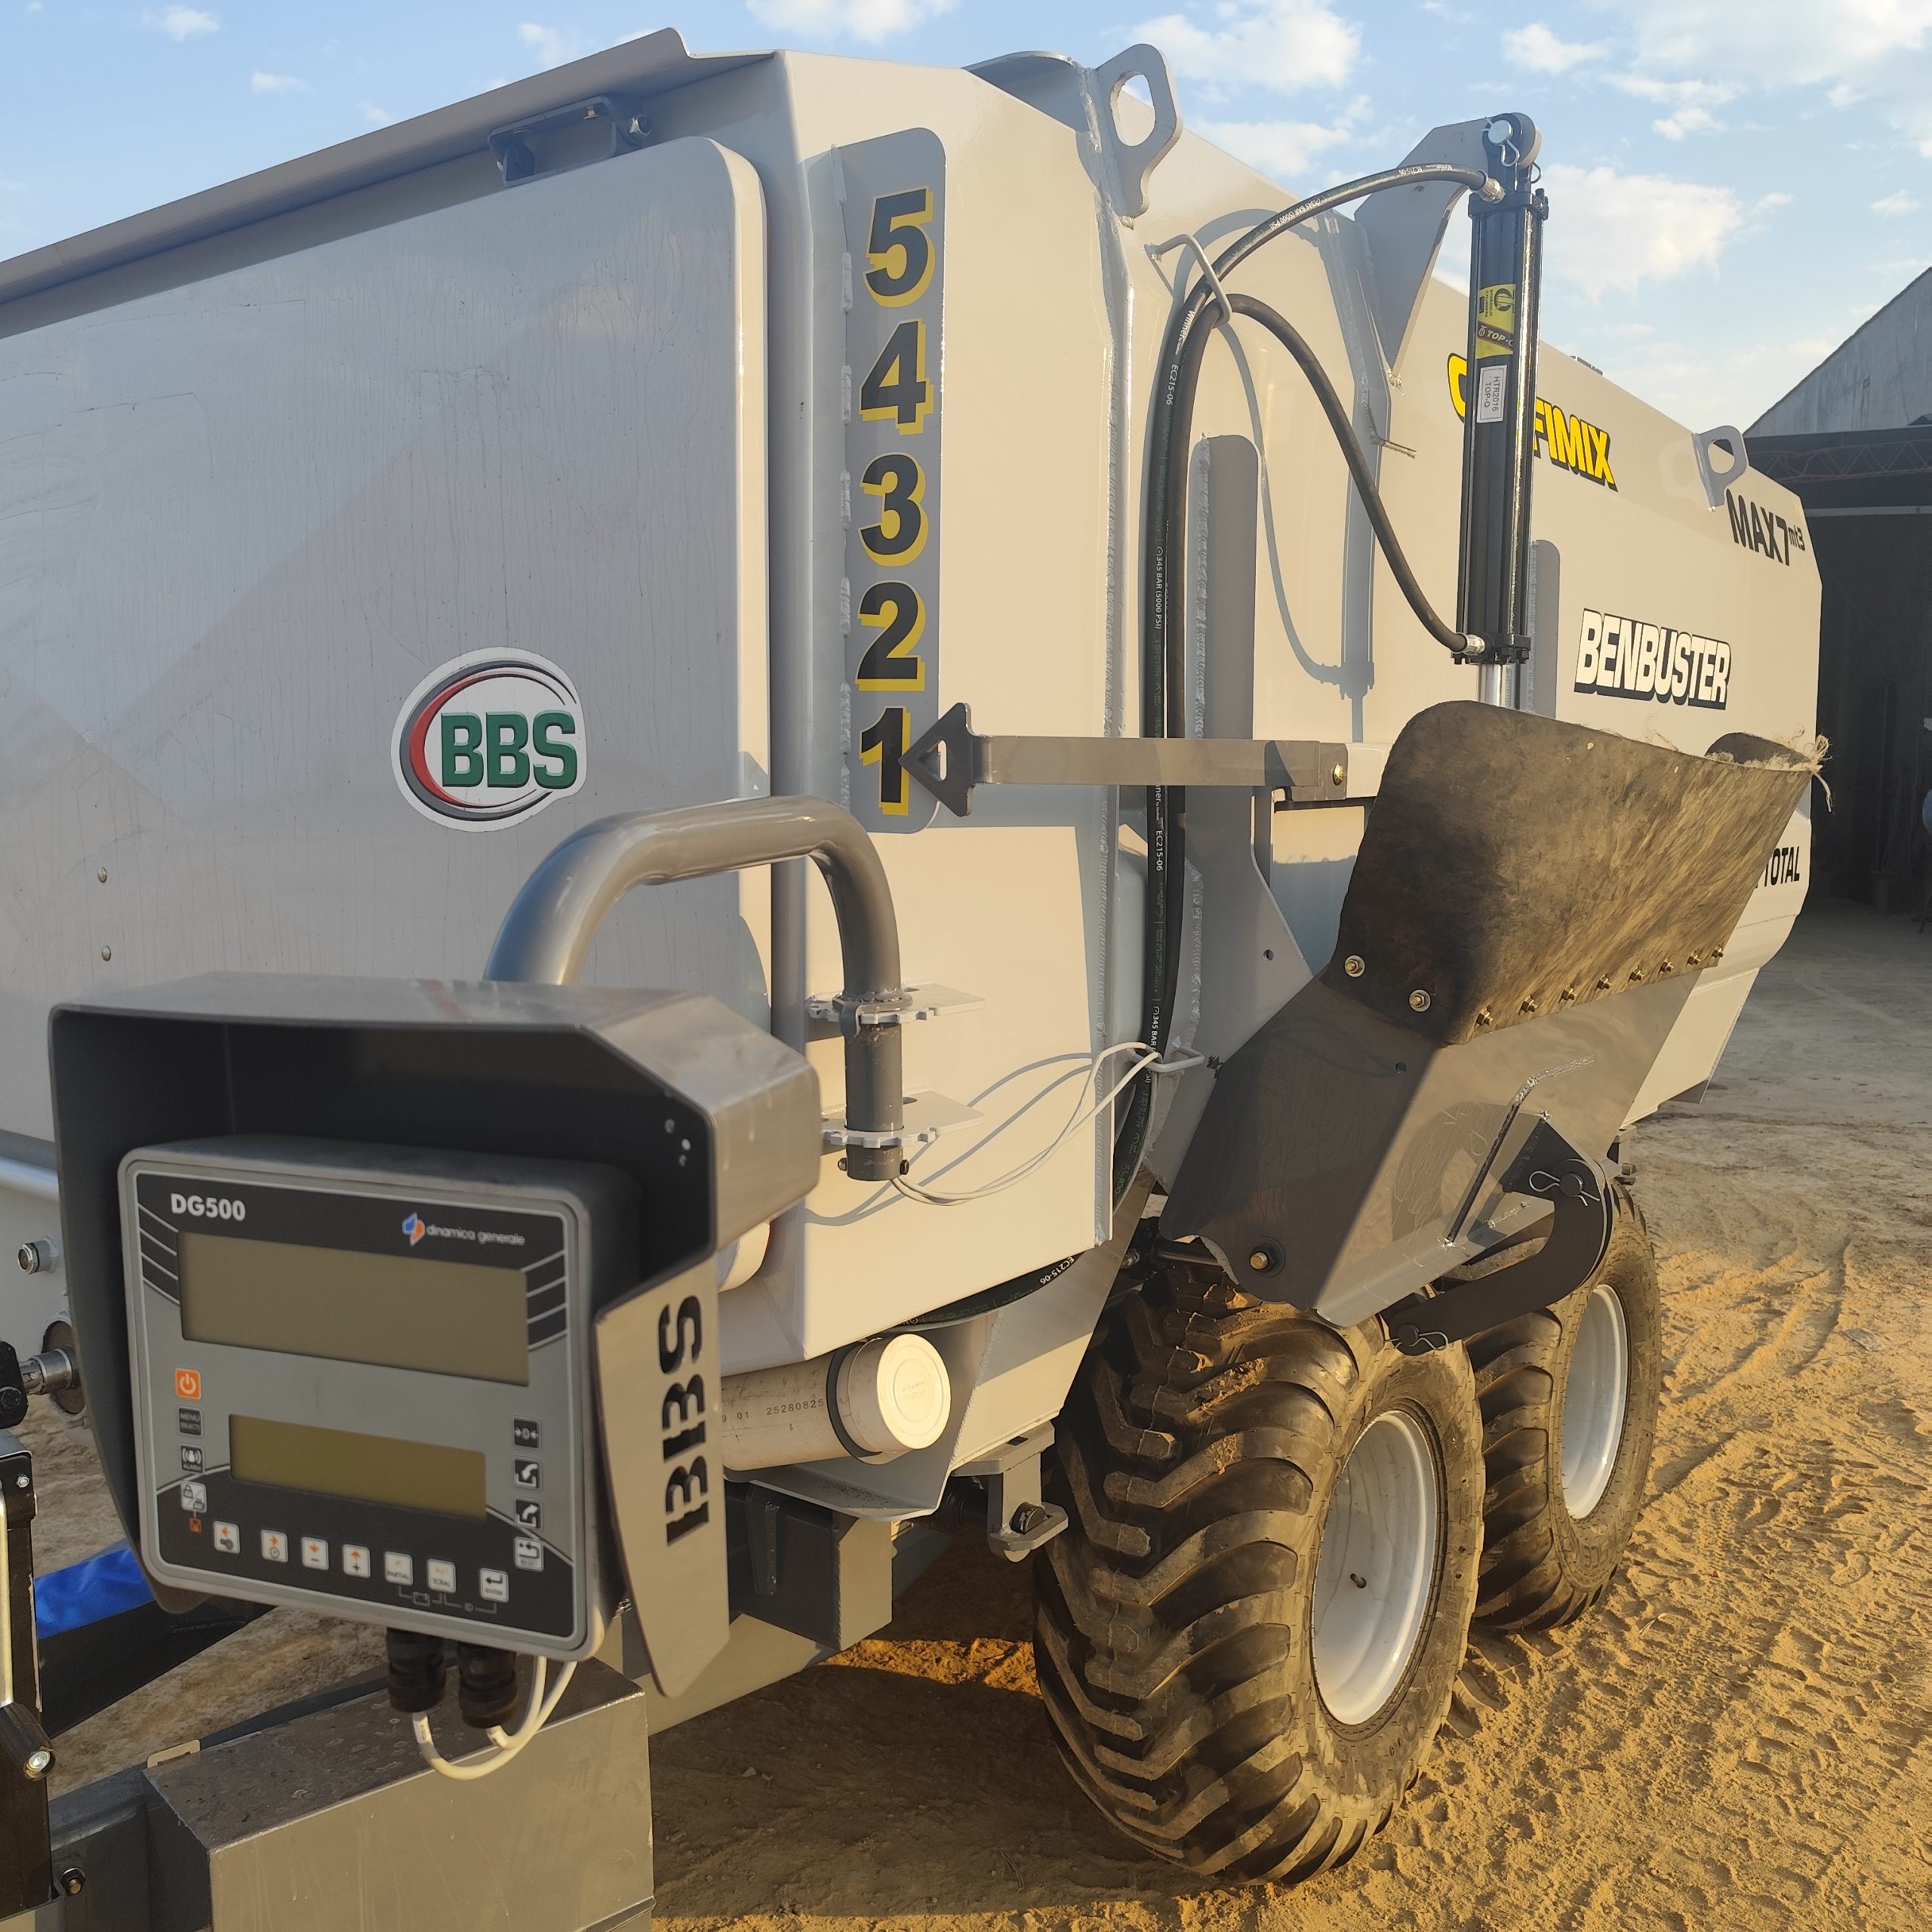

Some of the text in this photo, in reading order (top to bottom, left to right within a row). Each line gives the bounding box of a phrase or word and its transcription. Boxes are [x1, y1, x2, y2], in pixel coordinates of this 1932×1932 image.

[1294, 206, 1306, 216] BAR
[863, 186, 936, 308] 5
[1180, 310, 1196, 340] Winner
[859, 318, 934, 435] 4
[1166, 364, 1179, 405] EC215-06
[1492, 376, 1500, 412] HTR2016
[857, 452, 929, 566] 3
[855, 580, 926, 692] 2
[1154, 614, 1162, 629] PSI)
[1574, 608, 1732, 711] BENBUSTER
[441, 709, 578, 789] BBS
[859, 706, 912, 817] 1
[1155, 830, 1164, 872] EC215-06
[171, 1193, 246, 1221] DG500
[426, 1224, 526, 1246] dinamica generale
[1039, 1255, 1075, 1284] EC215-06
[180, 1411, 200, 1423] MENU
[658, 1296, 709, 1547] BBS
[737, 1411, 749, 1420] 01
[766, 1398, 824, 1416] 25280825
